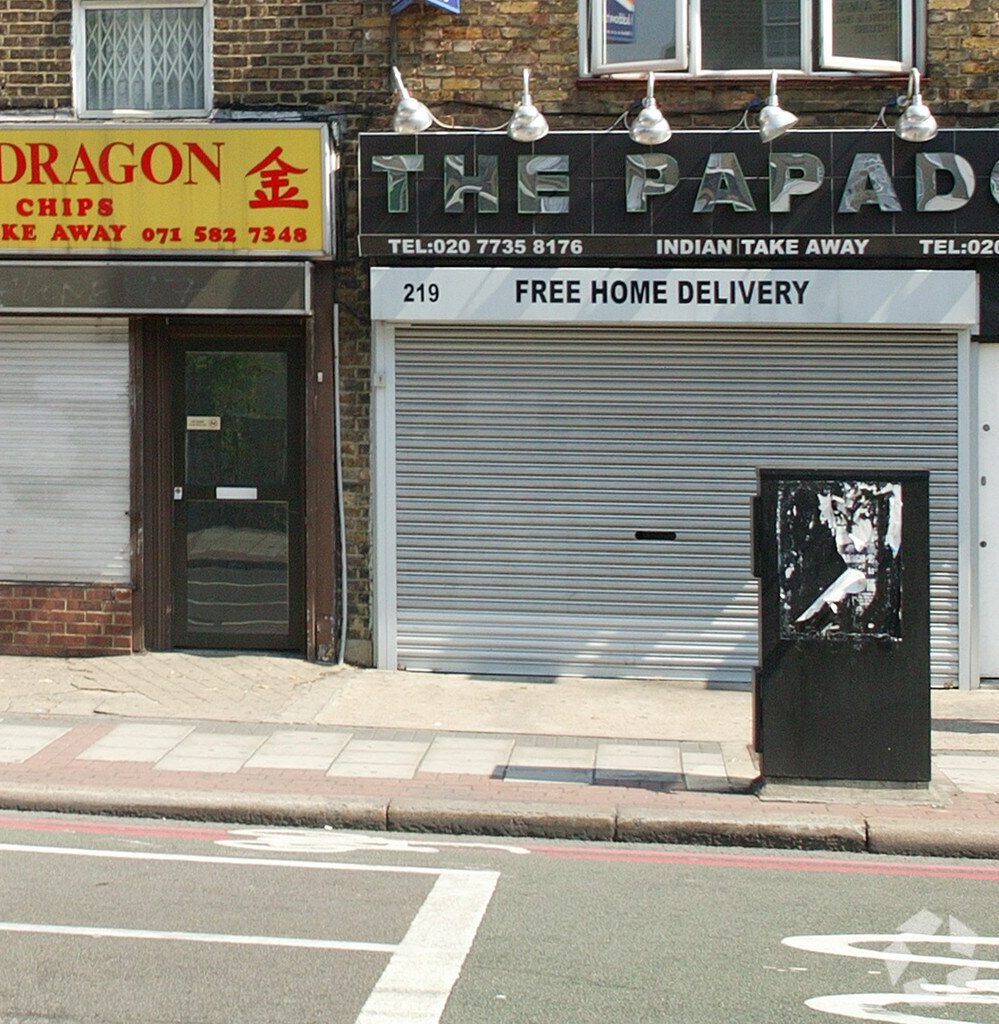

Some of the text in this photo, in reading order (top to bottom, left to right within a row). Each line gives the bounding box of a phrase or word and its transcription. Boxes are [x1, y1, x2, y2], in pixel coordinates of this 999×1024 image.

[244, 145, 311, 210] 金
[370, 151, 999, 215] THE PAPAD
[16, 197, 114, 217] CHIPS
[52, 223, 126, 241] AWAY
[142, 227, 181, 243] 071
[195, 226, 237, 243] 582
[249, 225, 308, 243] 7348
[387, 238, 583, 255] TEL:020 7735 8176
[656, 238, 870, 255] INDIAN TAKE AWAY
[403, 283, 440, 303] 219
[515, 279, 810, 305] FREE HOME DELIVERY
